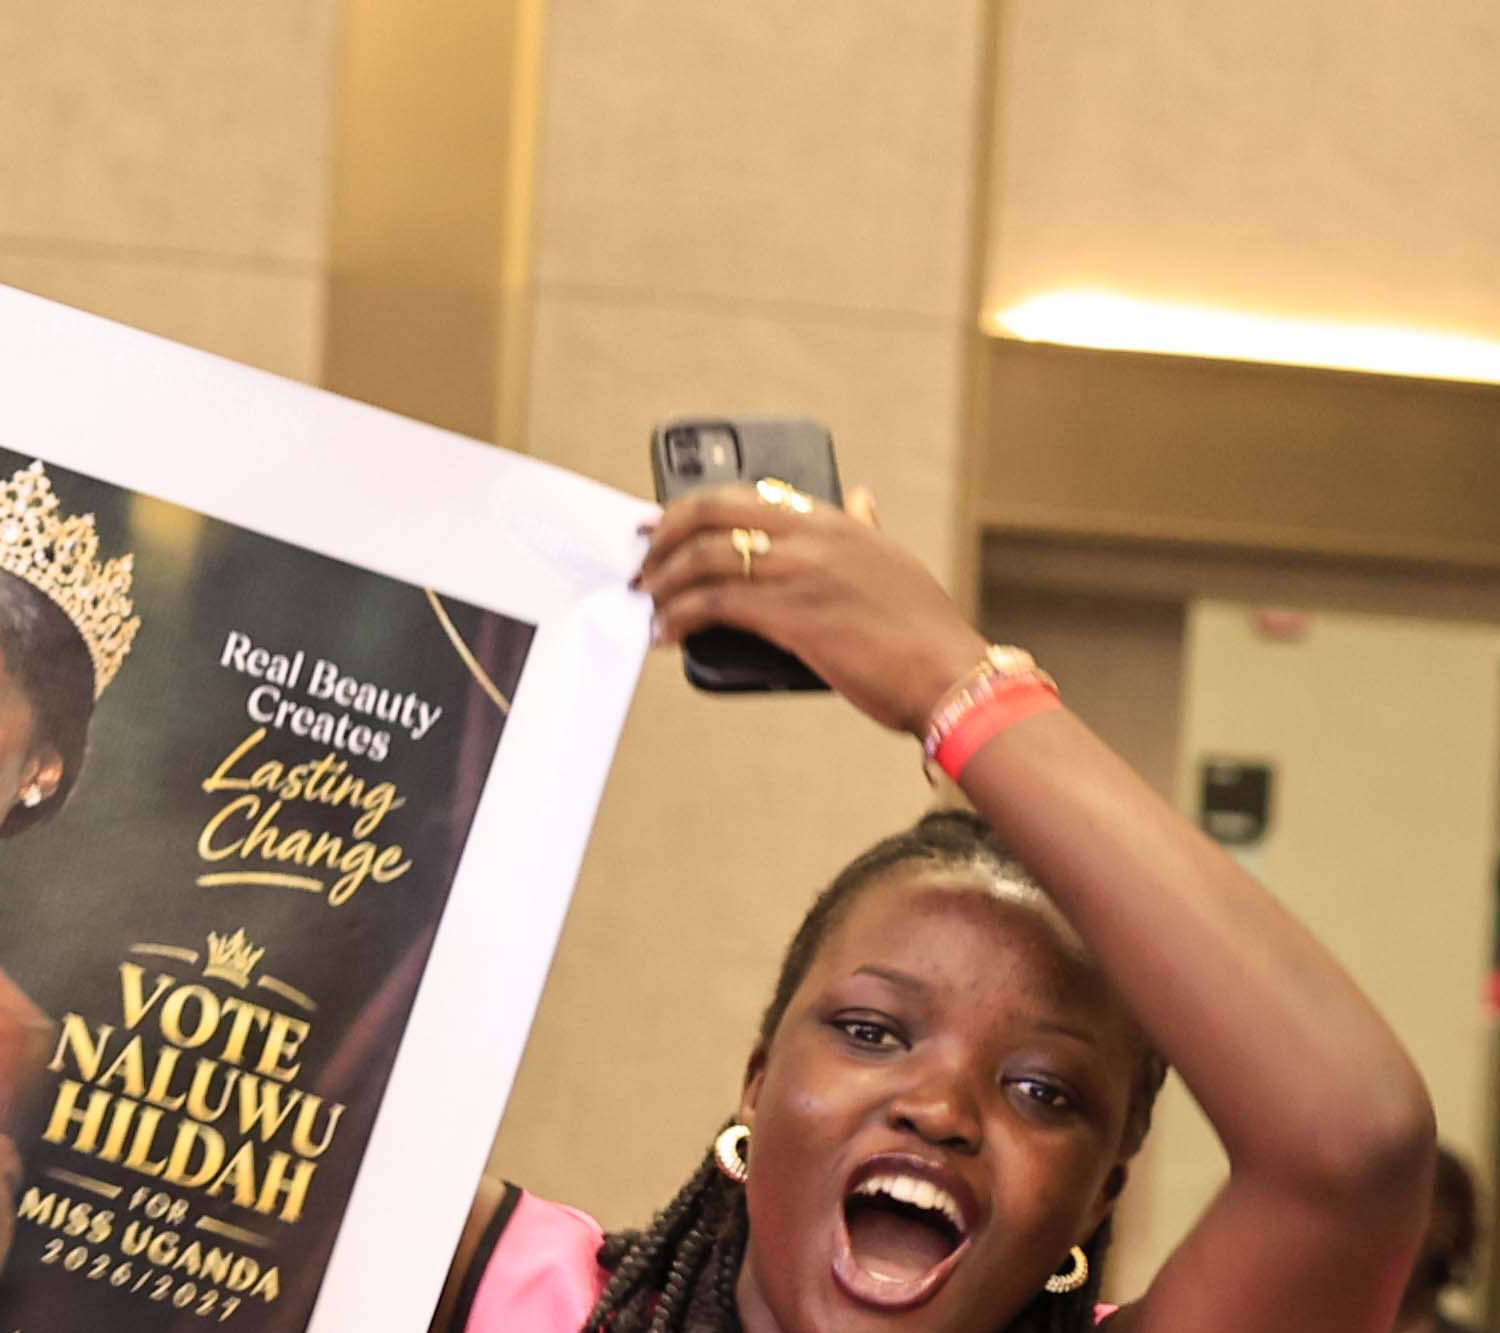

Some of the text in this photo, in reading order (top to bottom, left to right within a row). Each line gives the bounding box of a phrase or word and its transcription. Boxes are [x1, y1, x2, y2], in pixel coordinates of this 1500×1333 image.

[219, 629, 444, 741] Real Beauty
[246, 683, 392, 762] Creates
[201, 727, 407, 840] Lasting
[198, 793, 413, 907] Change
[118, 961, 312, 1083] VOTE
[46, 1011, 347, 1159] NALUWU
[41, 1078, 320, 1224] HILDAH
[128, 1186, 191, 1226] FOR
[17, 1185, 281, 1303] MISS UGANDA
[39, 1237, 243, 1323] 2026/2027
